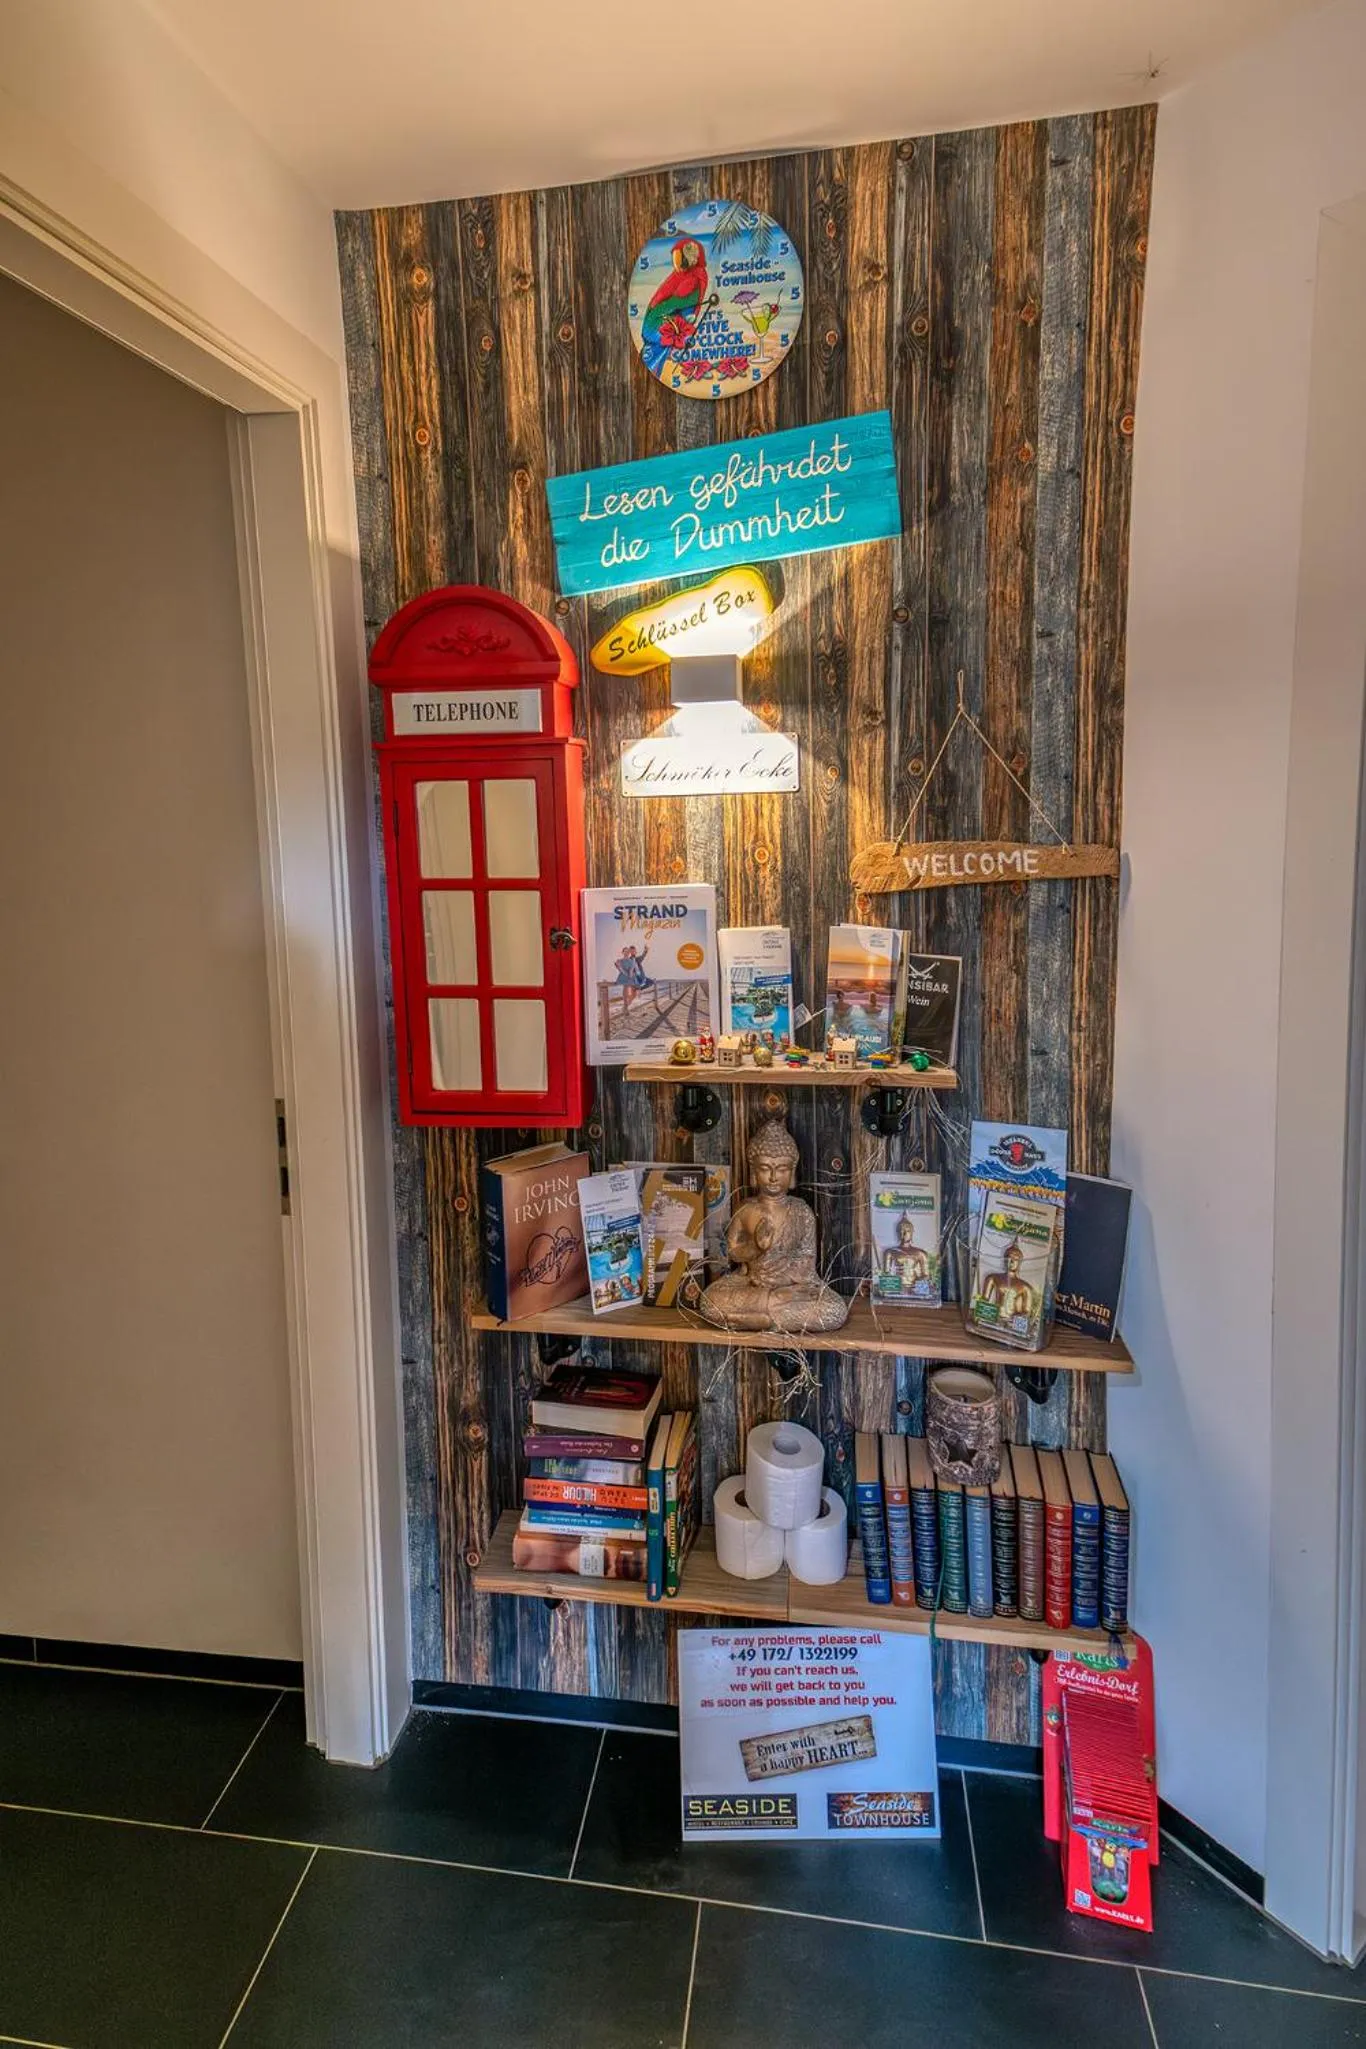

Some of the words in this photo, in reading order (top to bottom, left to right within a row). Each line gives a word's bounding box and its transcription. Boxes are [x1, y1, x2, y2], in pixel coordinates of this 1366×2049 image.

[708, 204, 717, 216] 5
[667, 221, 677, 234] 5
[780, 243, 789, 255] 5
[640, 257, 649, 269] 5
[721, 258, 771, 274] Seaside
[715, 270, 785, 288] Townhouse
[790, 287, 800, 300] 5
[629, 305, 638, 316] 5
[698, 320, 729, 334] FIVE
[780, 335, 790, 347] 5
[673, 344, 756, 362] SOMEWHERE!
[672, 376, 681, 388] 5
[752, 369, 761, 381] 5
[712, 385, 720, 396] 5
[579, 481, 673, 521] Lesen
[690, 433, 852, 510] gefährdet
[600, 528, 650, 568] die
[671, 484, 845, 560] Dummheit
[608, 602, 708, 662] Schlüssel
[713, 589, 756, 616] Box
[413, 701, 519, 722] TELEPHONE
[740, 748, 794, 779] Ecke
[903, 850, 1040, 877] WELCOME
[614, 903, 688, 920] STRAND
[621, 912, 681, 940] Magazin
[525, 1175, 569, 1203] JOHN
[1070, 1293, 1111, 1318] Martin
[711, 1636, 730, 1646] For
[734, 1637, 754, 1648] any
[758, 1634, 815, 1647] problems,
[818, 1634, 857, 1647] please
[860, 1634, 881, 1645] call
[729, 1648, 756, 1661] +49
[762, 1647, 792, 1661] 172/
[800, 1647, 858, 1661] 1322199
[736, 1666, 747, 1676] If
[750, 1667, 771, 1678] you
[774, 1665, 802, 1676] can't
[805, 1664, 838, 1675] reach
[730, 1683, 747, 1692] we
[750, 1681, 771, 1691] will
[775, 1681, 795, 1693] get
[799, 1680, 825, 1691] back
[829, 1681, 841, 1690] to
[844, 1681, 865, 1693] you
[700, 1698, 714, 1707] as
[717, 1698, 746, 1707] soon
[749, 1698, 763, 1707] as
[766, 1696, 816, 1709] possible
[819, 1695, 840, 1705] and
[843, 1695, 870, 1707] help
[872, 1696, 897, 1708] you.
[756, 1741, 788, 1757] Enter
[790, 1735, 816, 1750] with
[760, 1763, 768, 1773] a
[770, 1755, 804, 1771] happy
[688, 1798, 792, 1816] SEASIDE
[843, 1793, 914, 1814] Seaside
[834, 1812, 930, 1827] TOWNHOUSE
